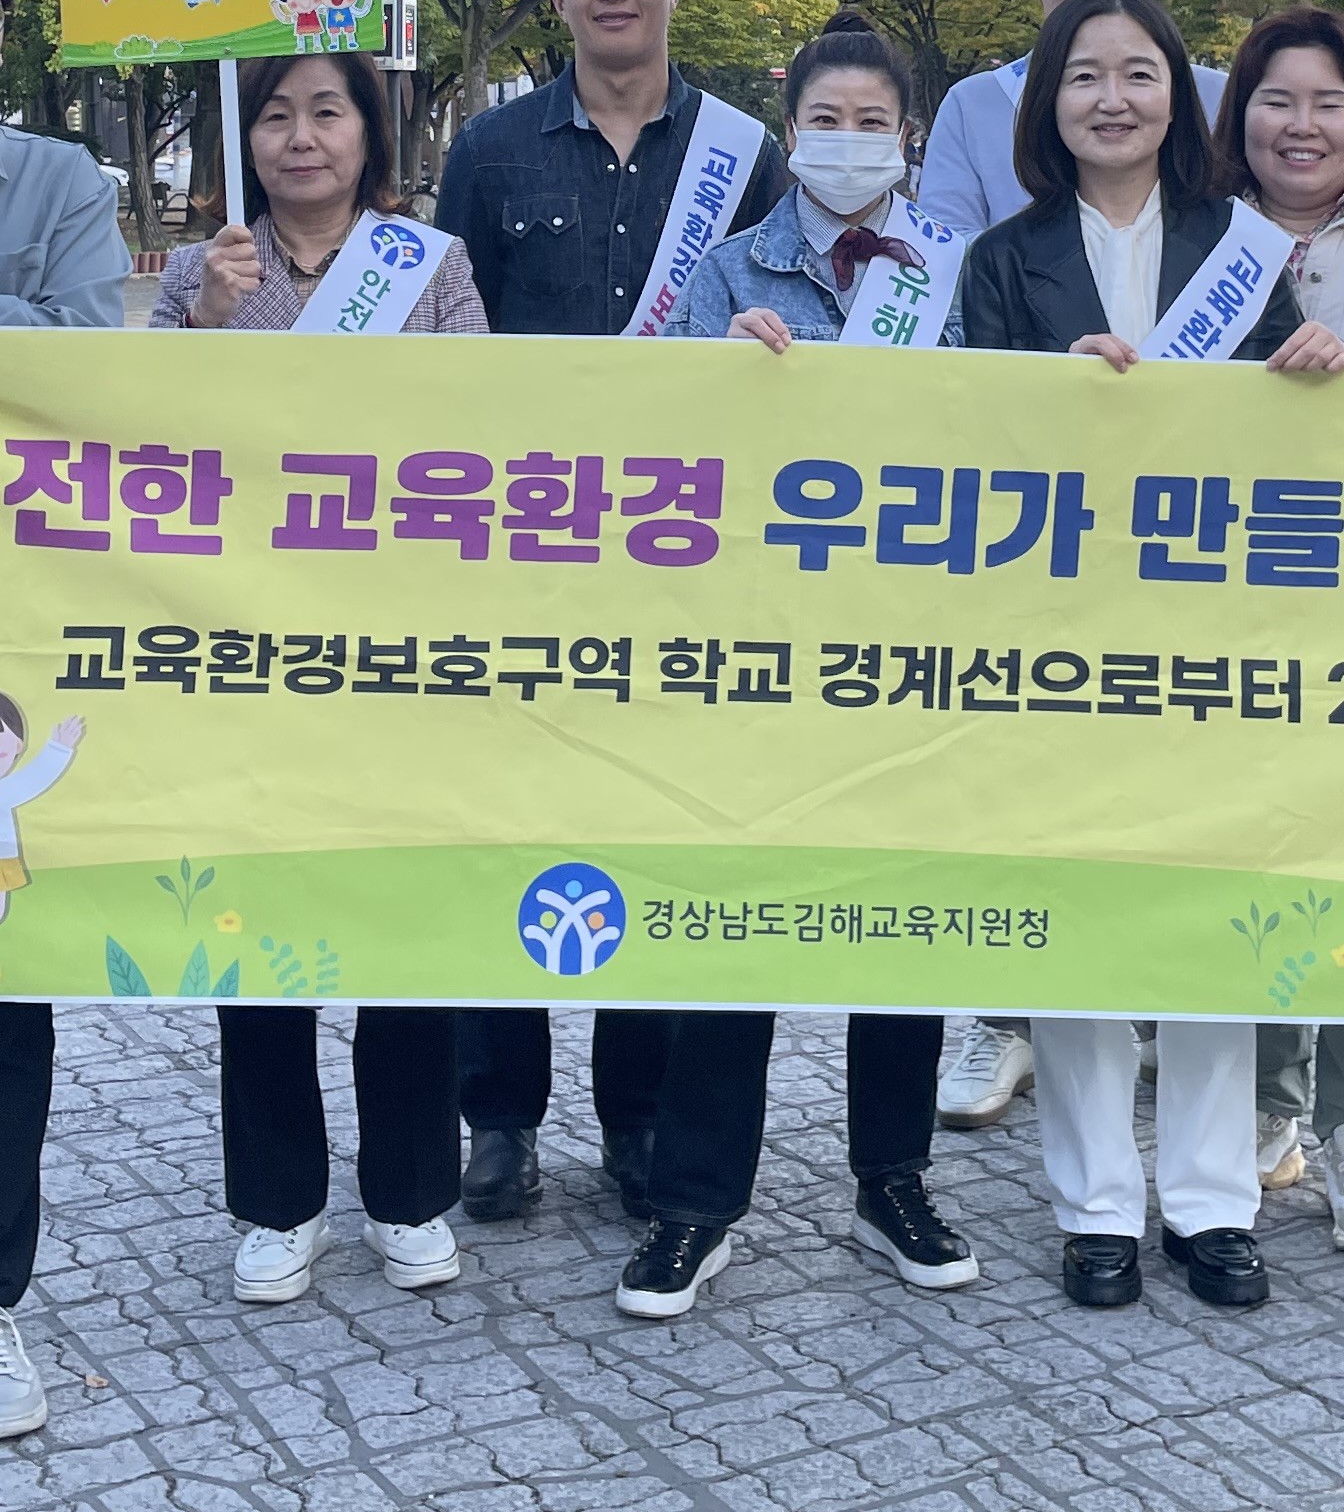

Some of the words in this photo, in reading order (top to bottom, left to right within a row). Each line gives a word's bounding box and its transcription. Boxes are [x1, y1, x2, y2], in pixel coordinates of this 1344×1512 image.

[335, 267, 393, 334] 안전
[270, 449, 726, 569] 교육환경
[763, 457, 1095, 579] 우리가
[54, 624, 634, 705] 교육환경보호구역
[657, 635, 792, 707] 학교
[818, 640, 1303, 723] 경계선으로부터
[641, 892, 1053, 952] 경상남도김해교육지원청
